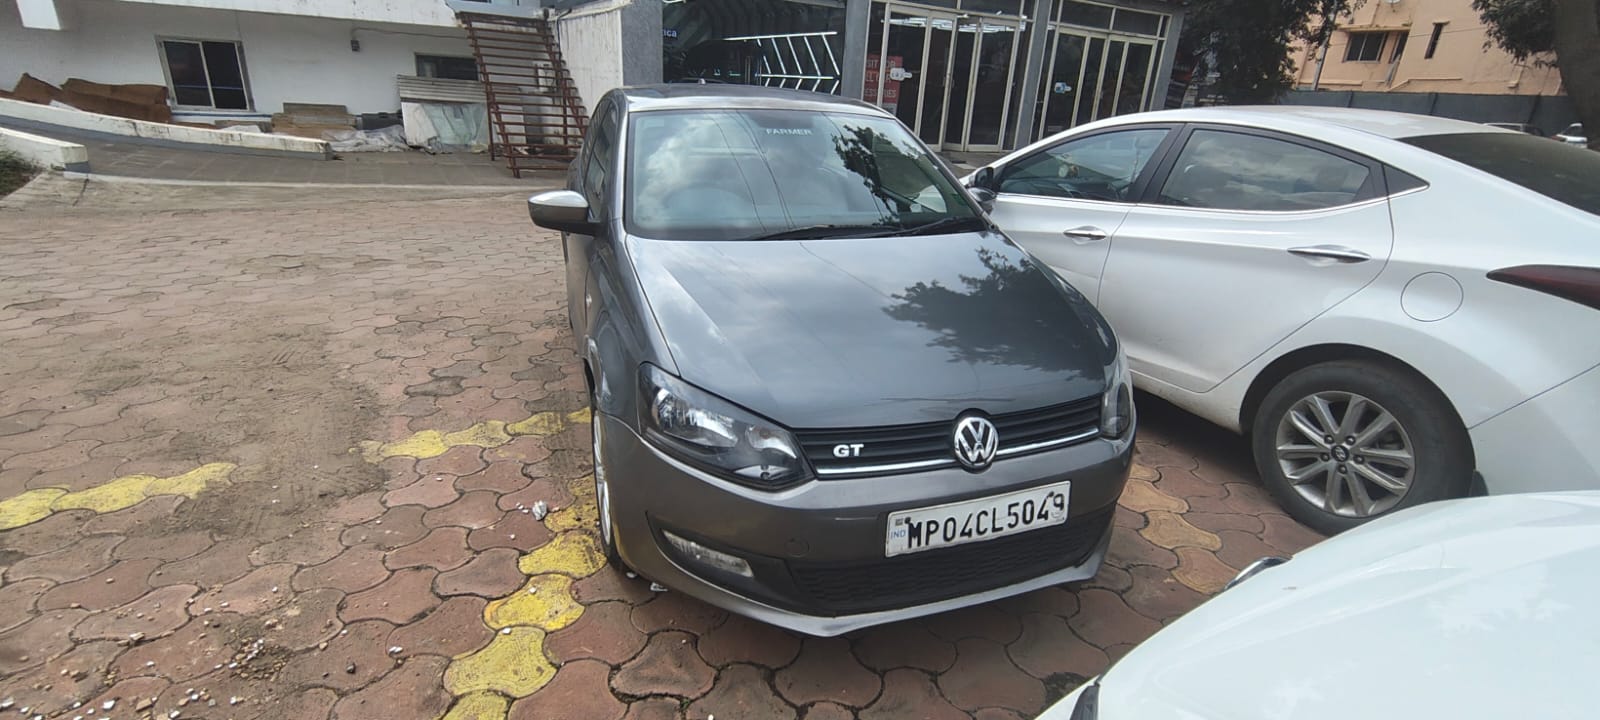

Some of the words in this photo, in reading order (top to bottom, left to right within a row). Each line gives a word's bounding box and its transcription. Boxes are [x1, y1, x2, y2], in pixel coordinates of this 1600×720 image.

[765, 128, 813, 136] FARMER
[833, 443, 864, 458] GT
[907, 491, 1065, 549] MP04CL5049
[890, 529, 906, 540] IND
